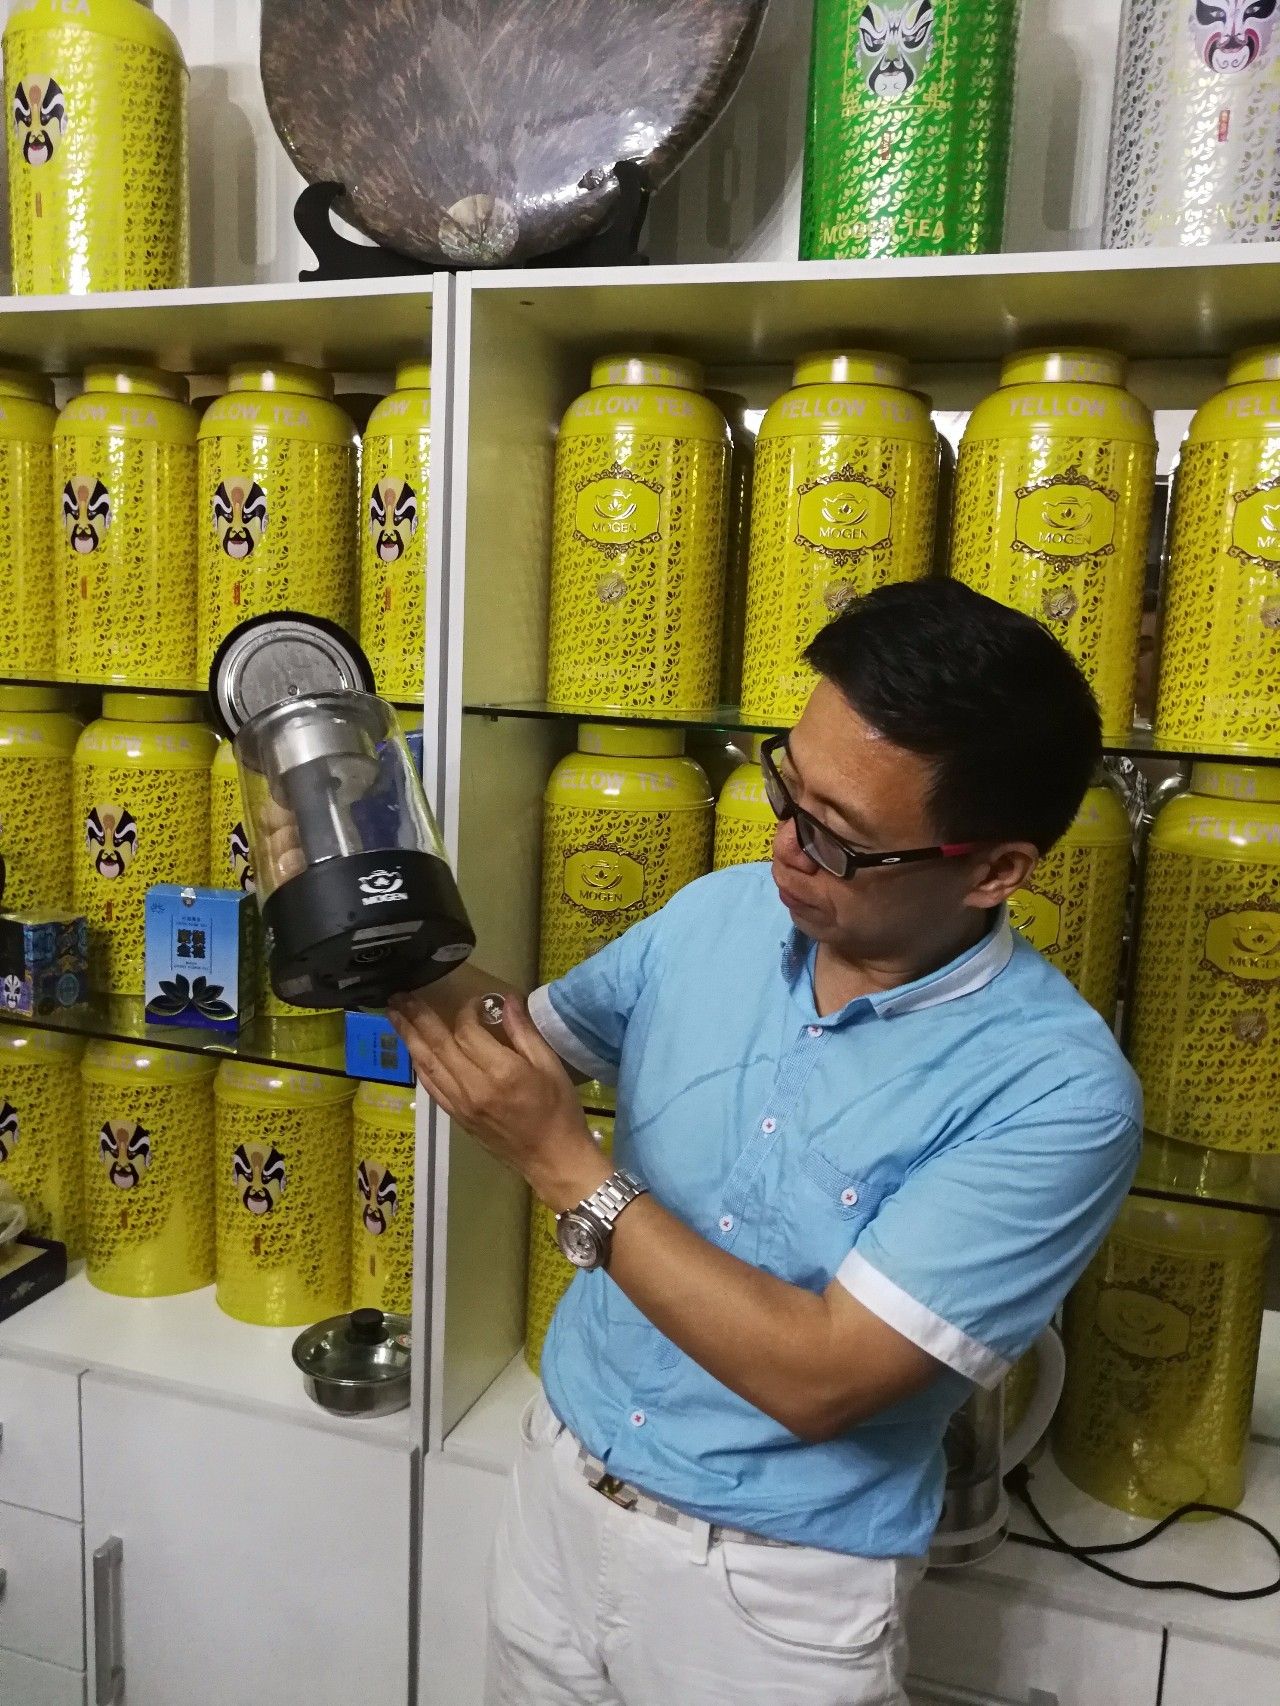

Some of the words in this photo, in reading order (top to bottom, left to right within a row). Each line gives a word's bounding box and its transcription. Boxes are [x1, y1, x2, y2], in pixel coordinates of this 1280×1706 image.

[902, 218, 945, 238] TEA
[273, 406, 309, 427] TEA
[654, 396, 695, 417] TEA
[780, 398, 866, 419] YELLOW
[1009, 396, 1106, 417] YELLOW
[121, 406, 158, 428] TEA
[592, 522, 637, 534] MOGEN
[819, 527, 868, 540] MOGEN
[1039, 532, 1091, 545] MOGEN
[154, 736, 192, 752] TEA
[637, 772, 677, 793] TEA
[580, 890, 622, 902] MOGEN
